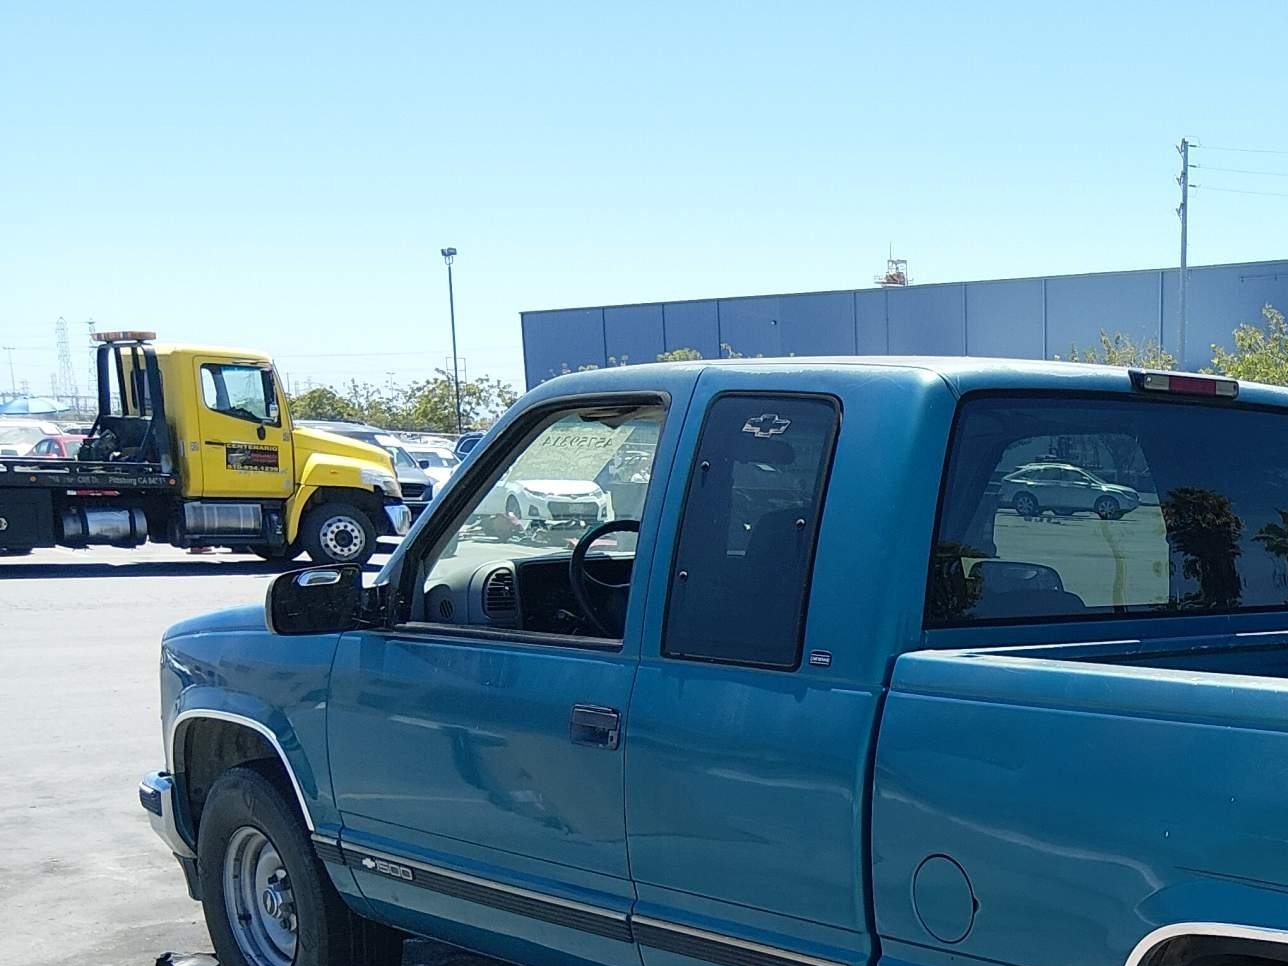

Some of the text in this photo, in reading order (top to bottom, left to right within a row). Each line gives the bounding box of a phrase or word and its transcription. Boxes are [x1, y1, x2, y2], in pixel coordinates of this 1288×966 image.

[226, 443, 278, 452] CENTENARIO
[137, 477, 147, 485] CA
[376, 859, 413, 880] 1500
